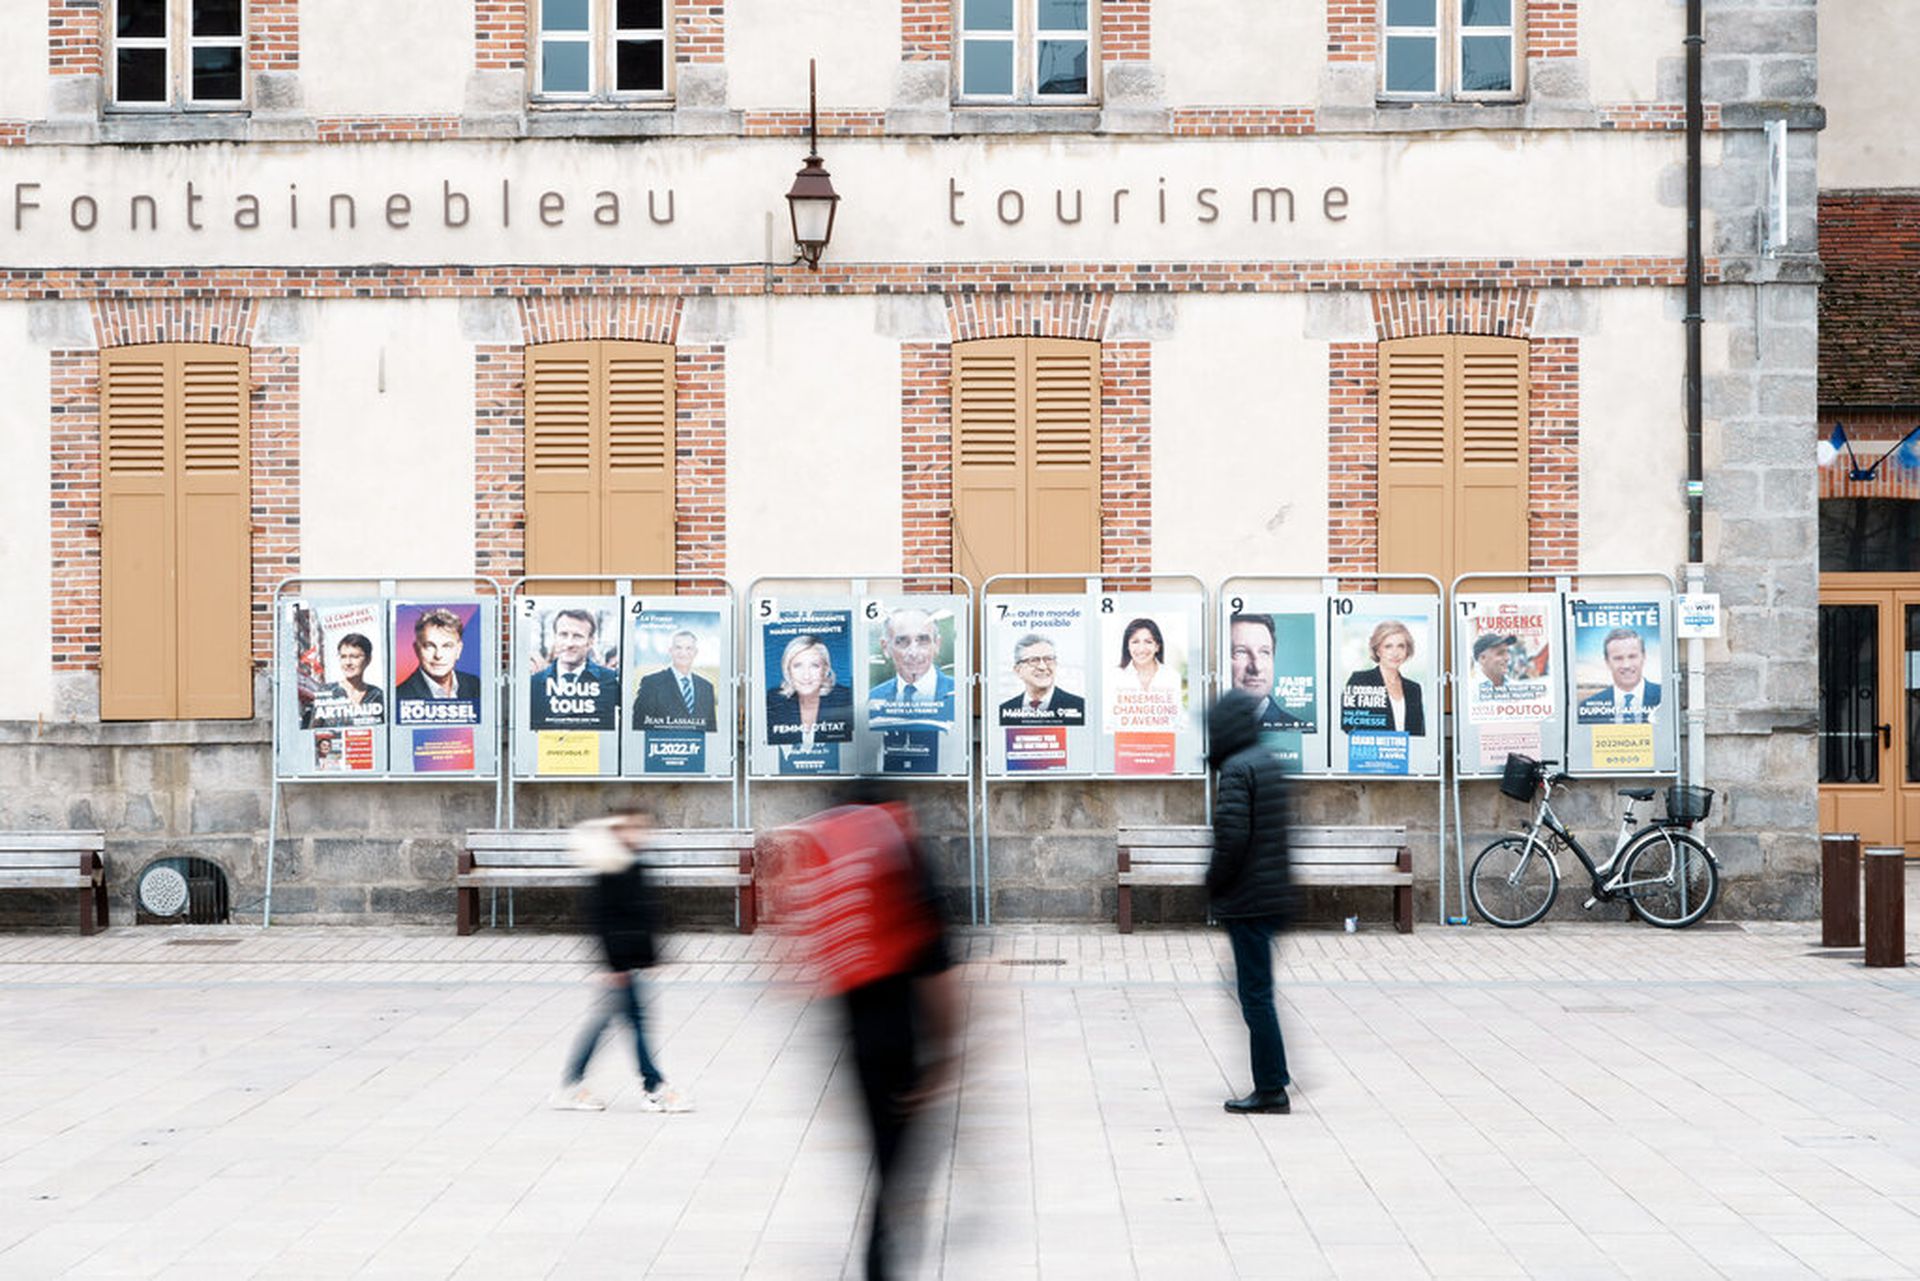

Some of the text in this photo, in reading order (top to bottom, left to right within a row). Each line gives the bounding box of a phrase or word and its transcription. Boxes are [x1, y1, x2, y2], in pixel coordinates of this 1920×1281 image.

[14, 177, 1349, 231] Fontainebleau tourisme
[760, 600, 771, 617] 5
[866, 602, 878, 619] 6
[996, 605, 1008, 620] 7
[1017, 607, 1081, 617] autre monde
[1101, 598, 1114, 613] 8
[1231, 597, 1243, 614] 9
[1333, 598, 1353, 615] 10
[1012, 619, 1071, 629] est possible
[1475, 615, 1543, 629] L'URGENCE
[1577, 608, 1658, 627] LIBERTÉ
[546, 677, 600, 697] Nous
[1278, 676, 1314, 687] FAIRE
[550, 696, 596, 714] tous
[1117, 694, 1174, 704] ENSEMBLE
[1344, 695, 1387, 708] DE FAIRE
[315, 703, 383, 719] ARTHAUD
[400, 705, 477, 719] ROUSSEL
[1112, 705, 1178, 716] CHANGEONS
[1496, 705, 1552, 715] POUTOU
